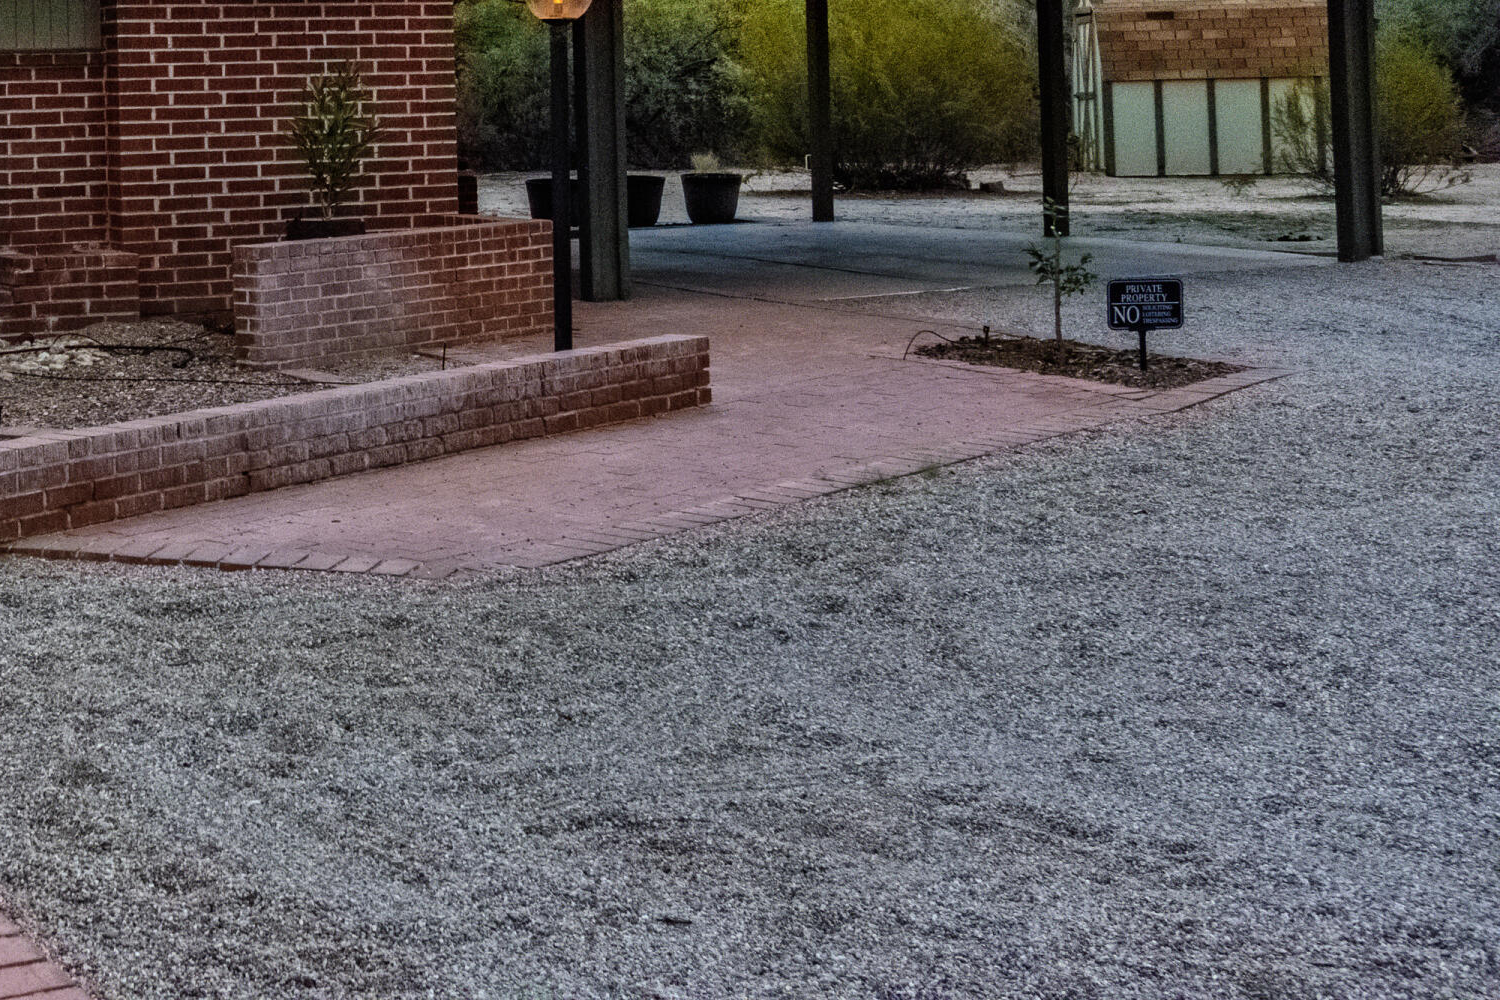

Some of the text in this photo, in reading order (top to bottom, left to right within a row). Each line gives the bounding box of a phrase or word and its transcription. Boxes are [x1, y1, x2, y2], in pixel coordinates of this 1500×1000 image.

[1126, 285, 1163, 293] PRIVATE
[1121, 293, 1167, 303] PROPERTY
[1113, 305, 1140, 324] NO
